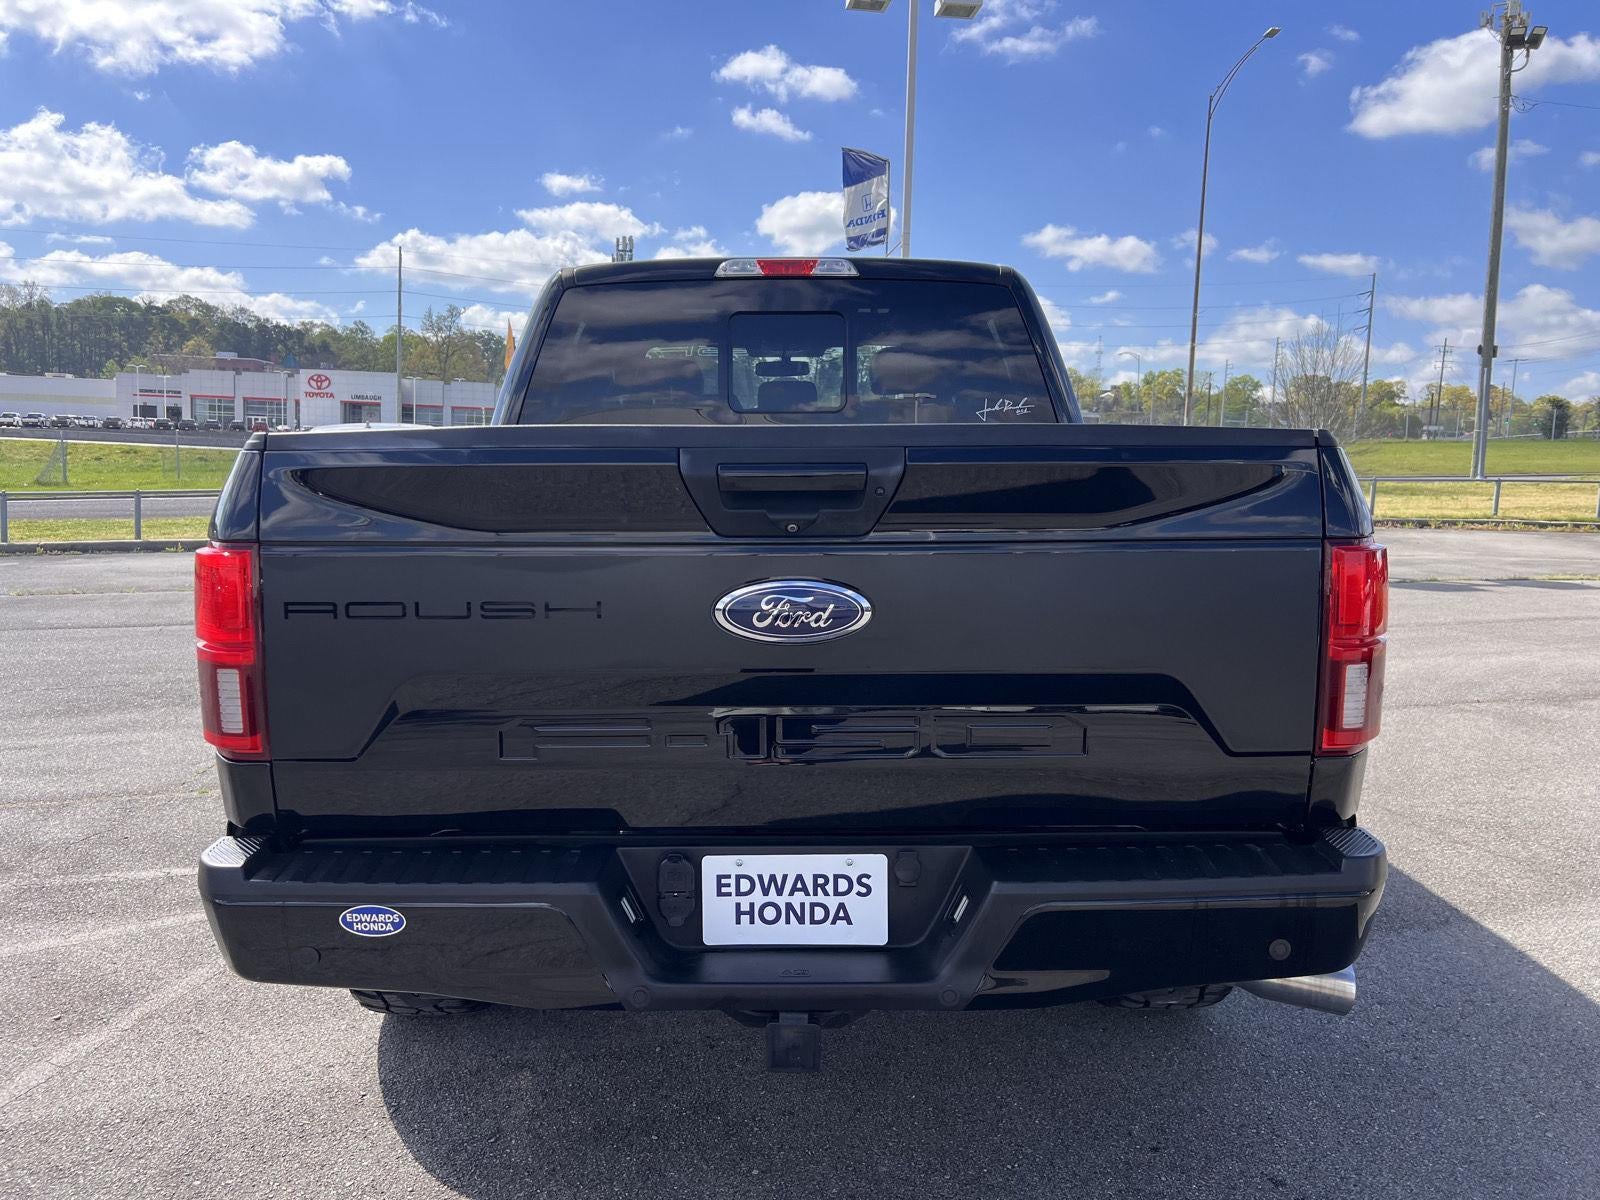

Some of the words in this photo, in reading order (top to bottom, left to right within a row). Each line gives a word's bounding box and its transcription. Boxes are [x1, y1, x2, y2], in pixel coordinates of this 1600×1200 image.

[283, 601, 602, 620] ROUSH
[752, 594, 835, 628] Ford
[498, 713, 1088, 761] F-150
[716, 873, 873, 898] EDWARDS
[346, 913, 399, 923] EDWARDS
[735, 902, 853, 926] HONDA
[353, 923, 394, 931] HONDA
